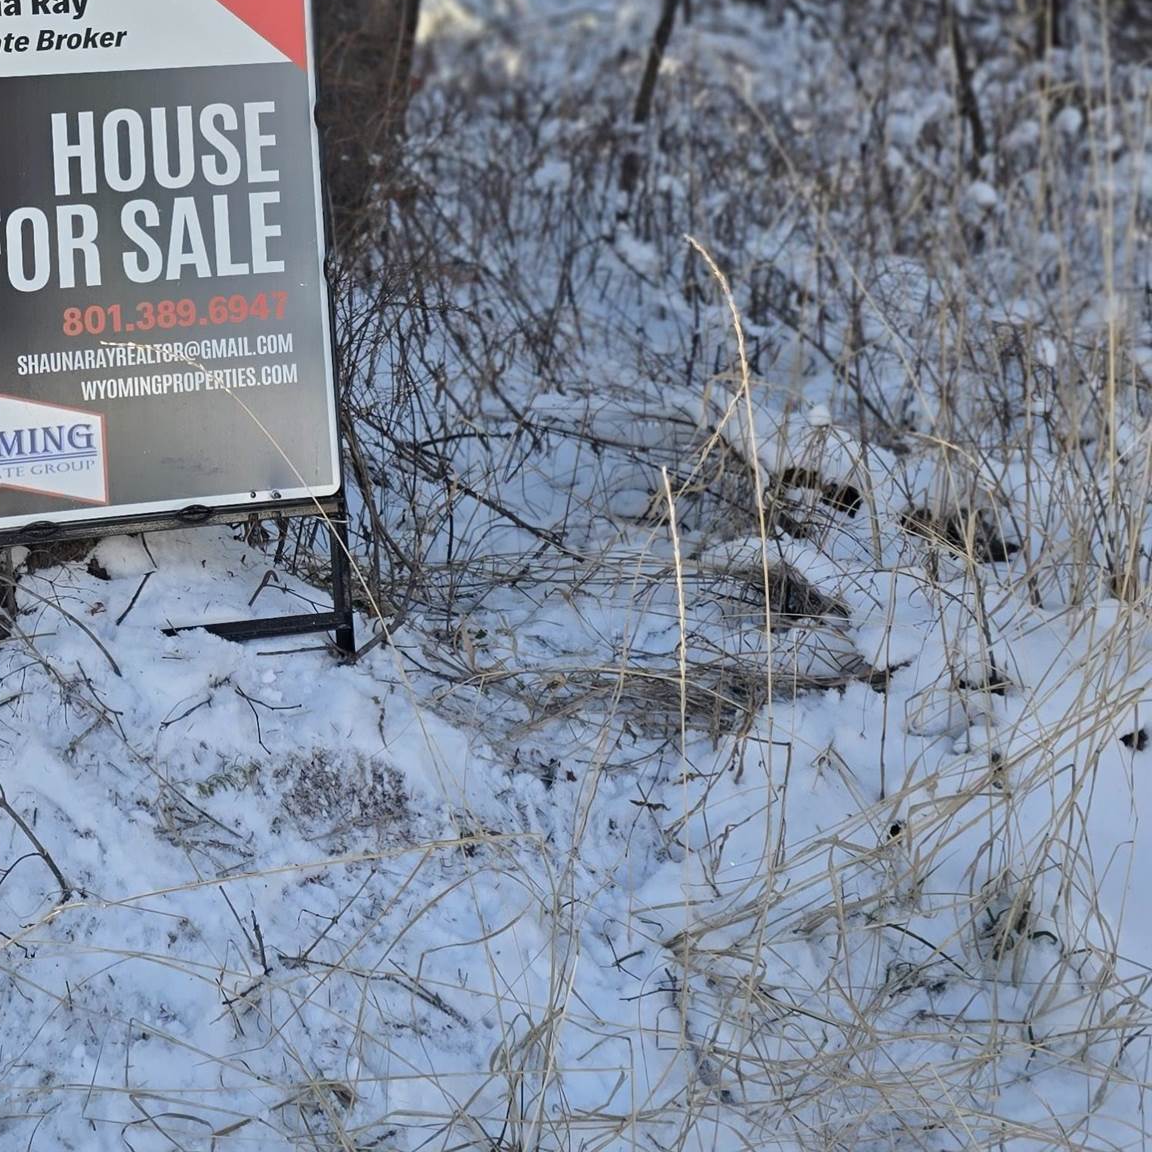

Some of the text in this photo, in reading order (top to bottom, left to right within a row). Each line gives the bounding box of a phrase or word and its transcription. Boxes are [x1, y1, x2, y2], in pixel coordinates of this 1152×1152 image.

[36, 28, 127, 52] Broker
[51, 101, 280, 196] HOUSE
[120, 191, 285, 284] SALE
[62, 291, 288, 337] 801.389.6947
[17, 333, 293, 375] SHAUNARAYREALTOR@GMAIL.COM
[81, 364, 298, 401] WYOMINGPROPERTIES.COM
[31, 459, 96, 476] GROUP
